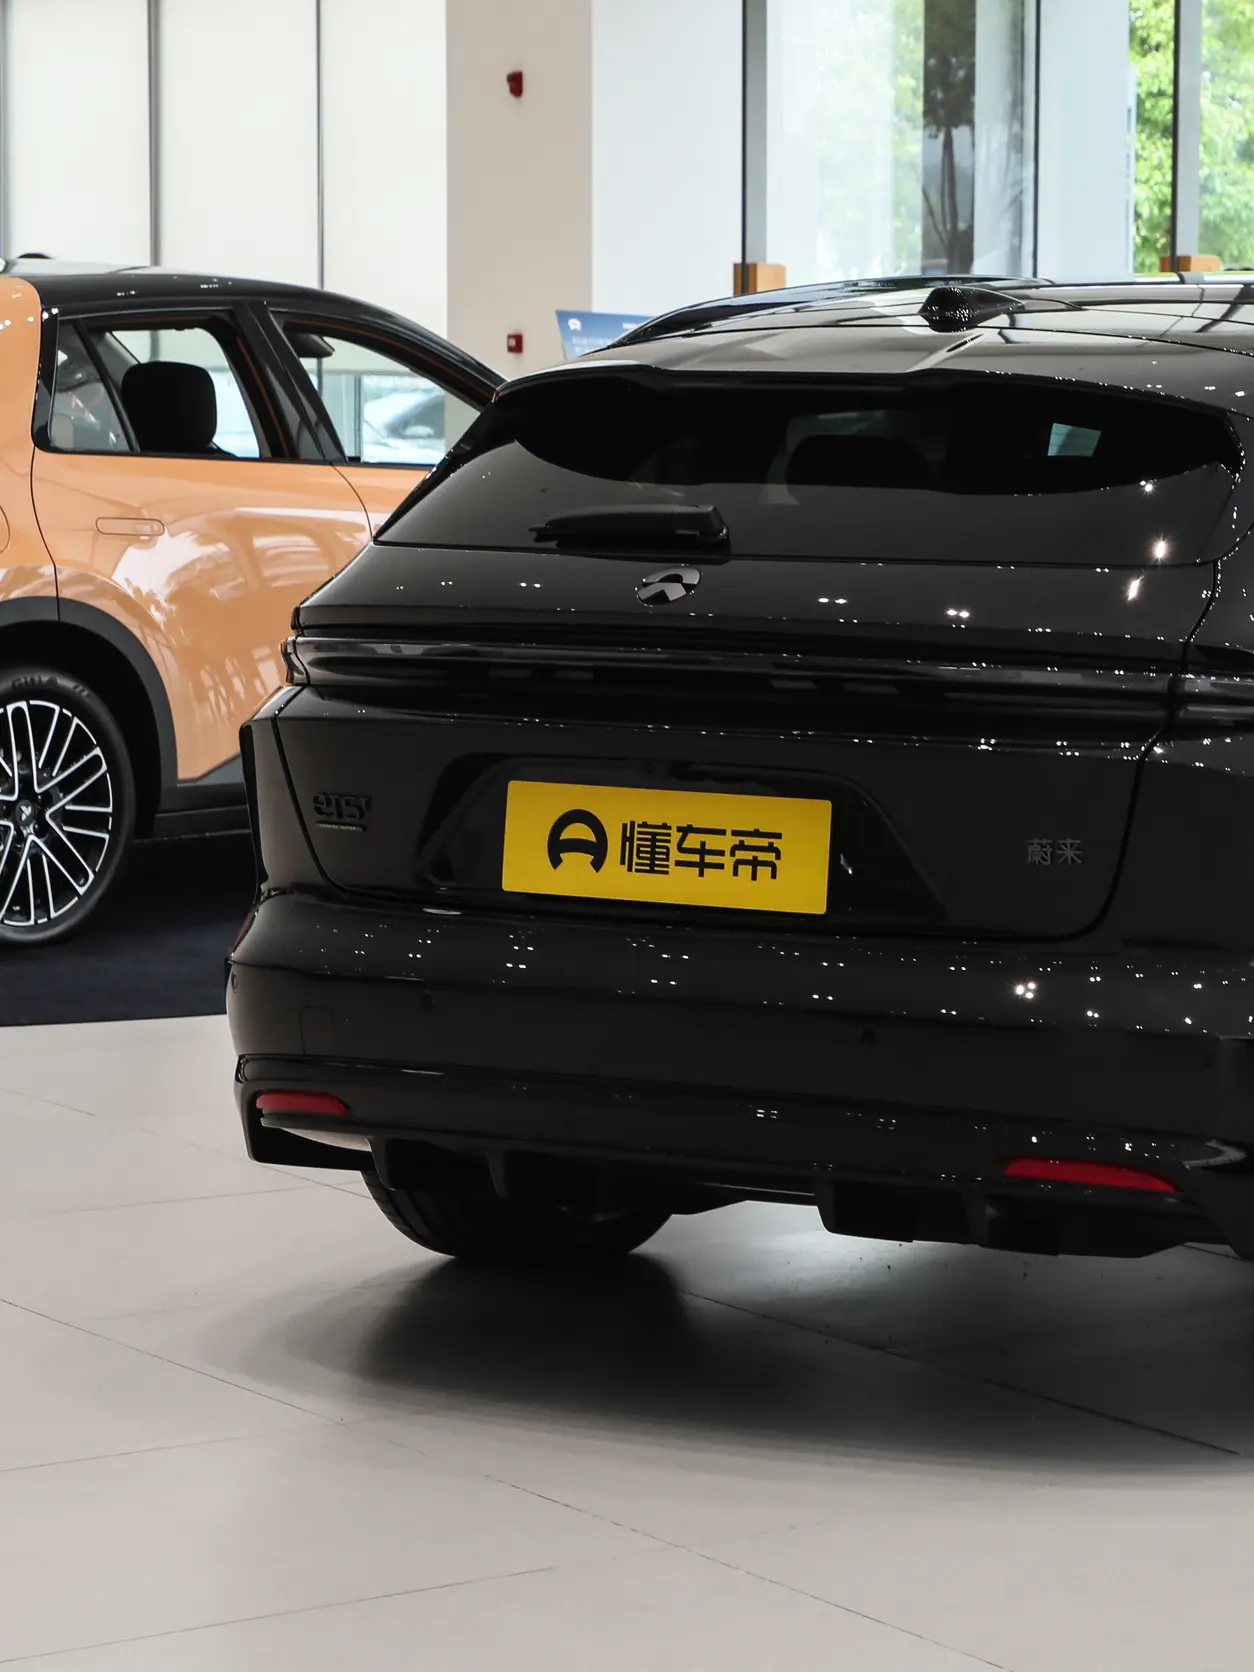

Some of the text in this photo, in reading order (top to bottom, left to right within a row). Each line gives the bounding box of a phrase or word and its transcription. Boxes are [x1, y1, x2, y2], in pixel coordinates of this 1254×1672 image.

[620, 820, 783, 881] 懂车帝
[1026, 838, 1083, 866] 蔚来
